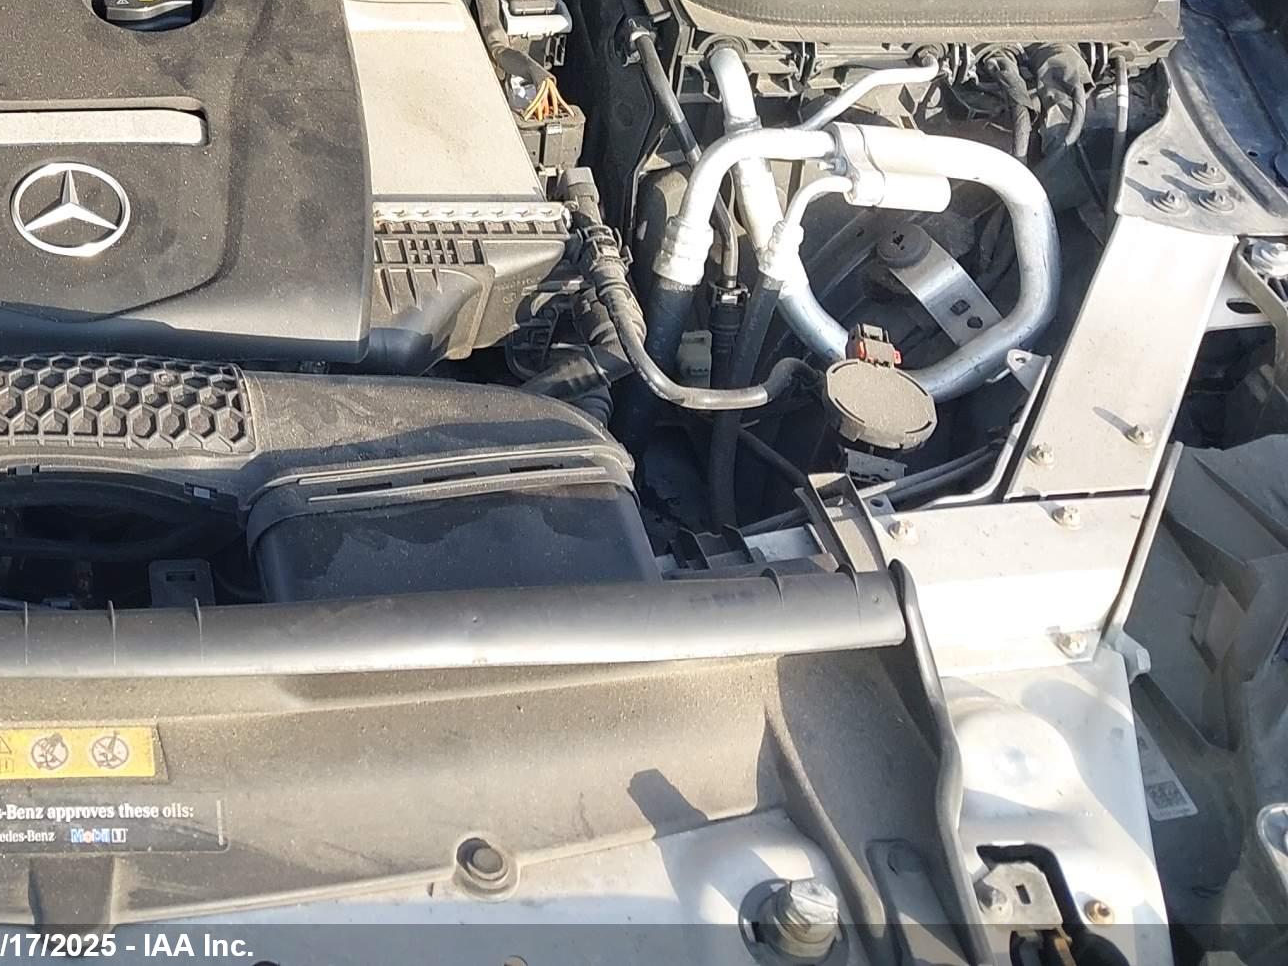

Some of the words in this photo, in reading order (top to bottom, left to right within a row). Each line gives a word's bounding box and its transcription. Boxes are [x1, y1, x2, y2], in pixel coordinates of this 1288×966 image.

[47, 805, 115, 823] approves
[118, 802, 159, 818] these
[162, 802, 194, 818] oils:
[70, 828, 111, 843] Mobil
